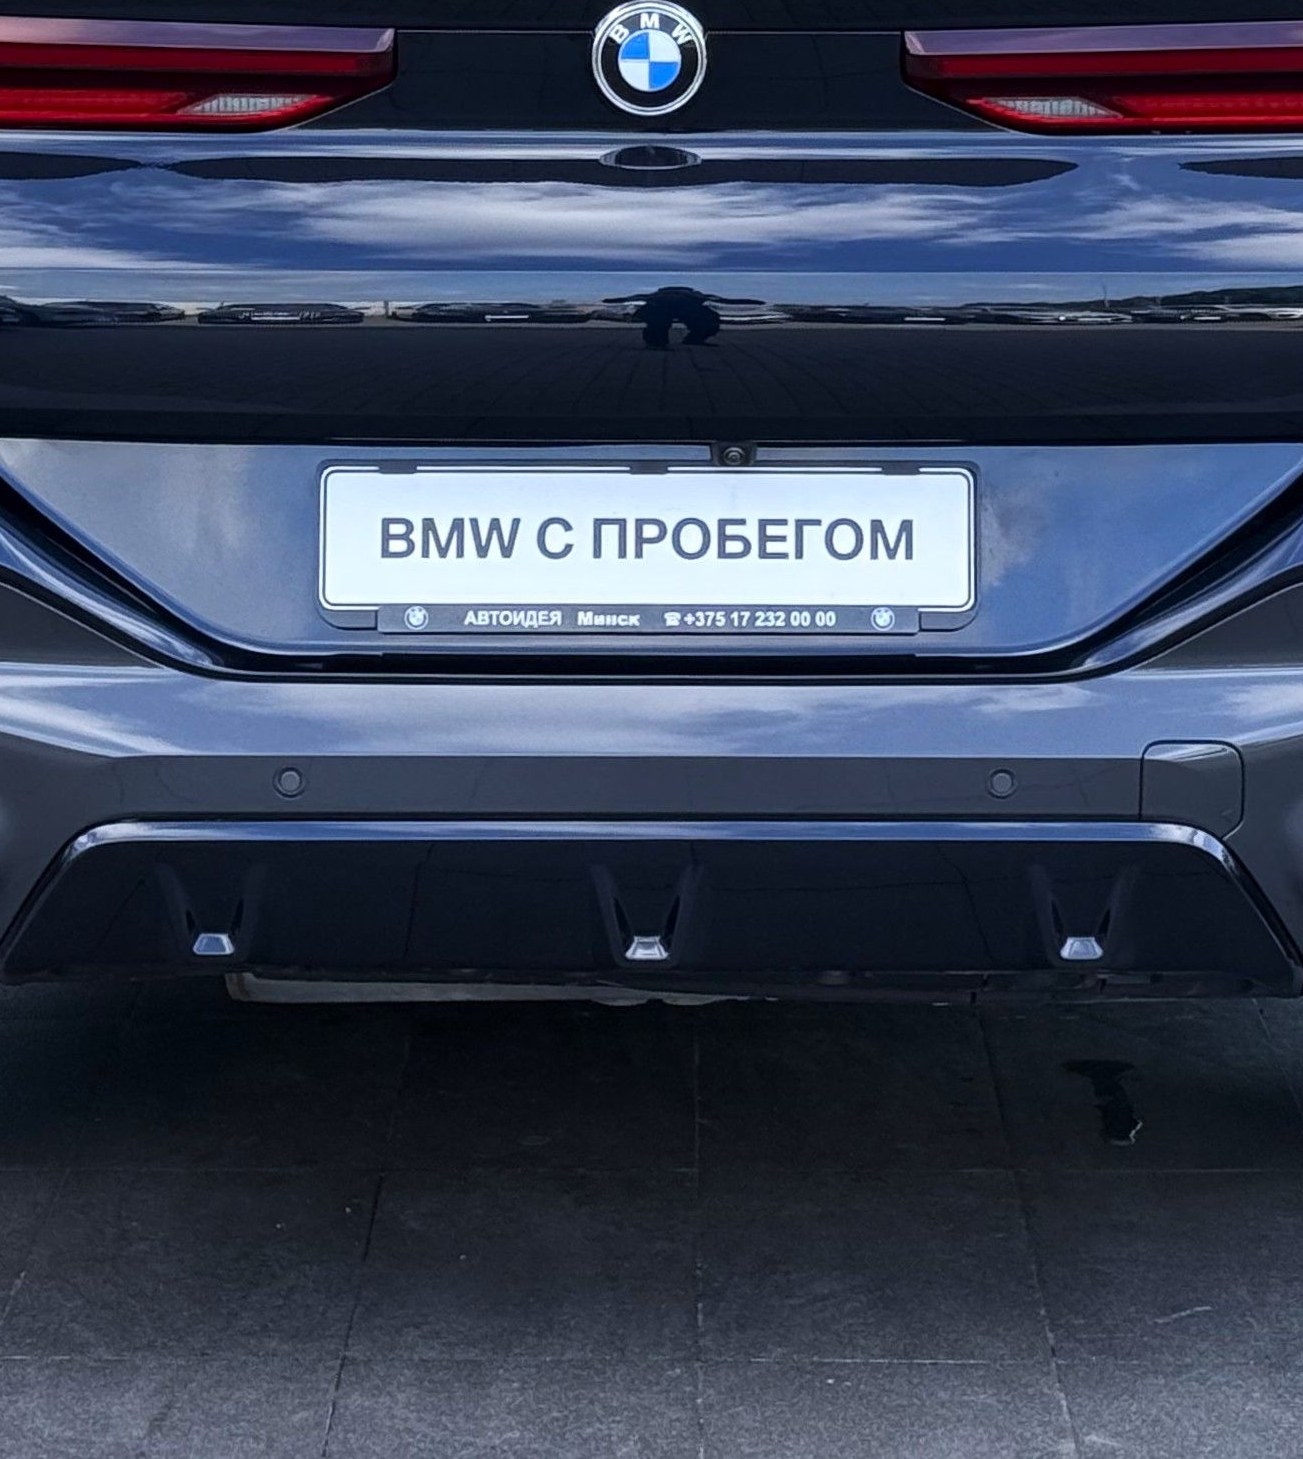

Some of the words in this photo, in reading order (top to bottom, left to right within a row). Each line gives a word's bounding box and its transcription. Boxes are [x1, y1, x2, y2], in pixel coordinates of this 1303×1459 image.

[609, 13, 693, 45] BMW
[380, 517, 521, 559] BMW
[536, 516, 575, 560] С
[592, 517, 914, 560] ПРОБЕГОМ
[463, 610, 563, 629] АВТОИДЕЯ
[577, 611, 641, 627] Минск
[683, 611, 726, 627] +375
[730, 611, 751, 627] 17
[754, 611, 786, 627] 232
[789, 611, 812, 627] 00
[814, 611, 837, 627] 00
